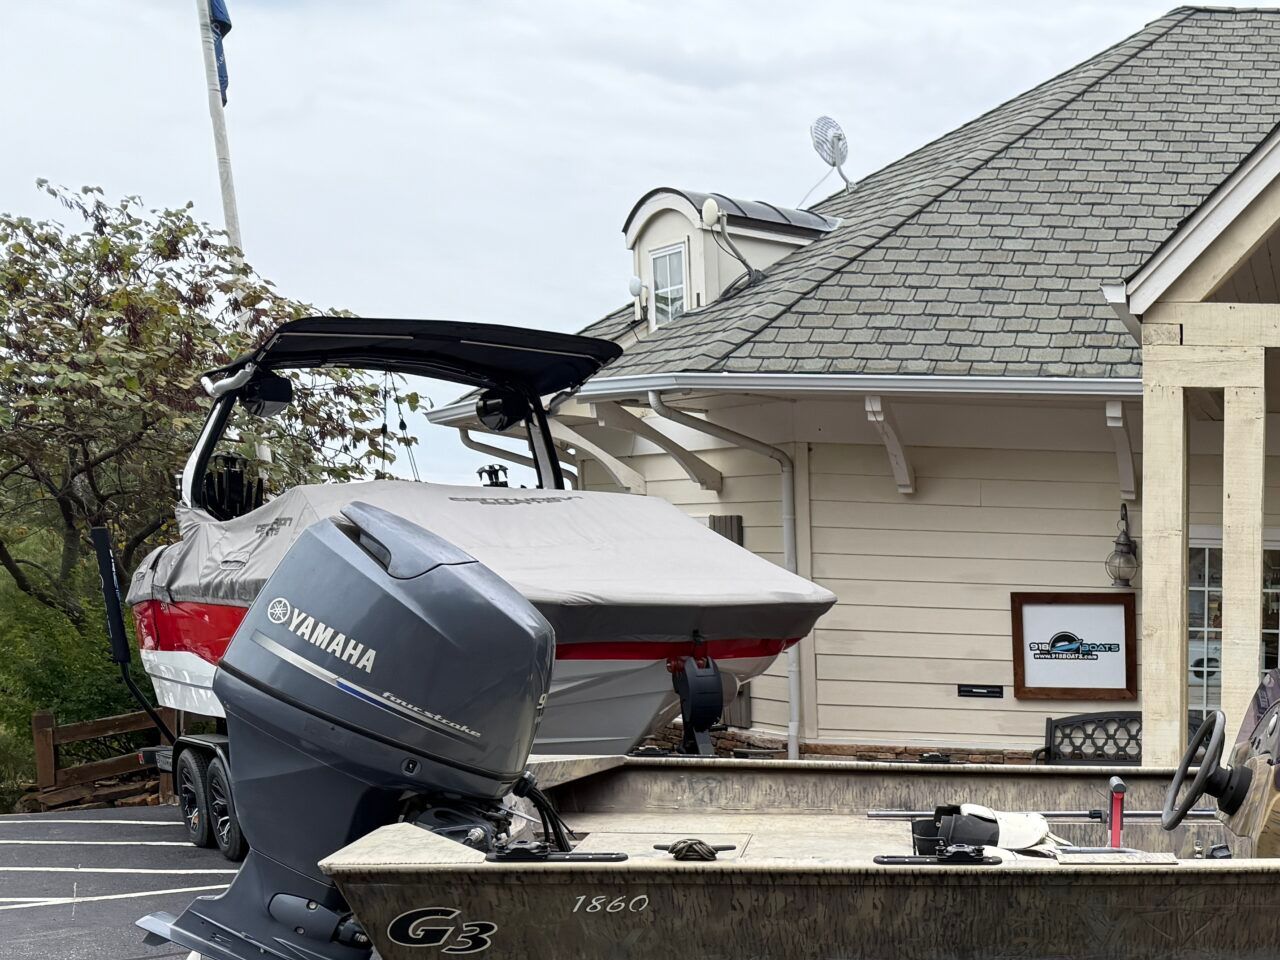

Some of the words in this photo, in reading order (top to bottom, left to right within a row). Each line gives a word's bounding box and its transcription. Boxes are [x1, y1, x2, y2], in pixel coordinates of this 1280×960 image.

[287, 608, 376, 674] YAMAHA
[1030, 643, 1050, 651] 918
[1081, 644, 1120, 652] BOATS
[572, 895, 649, 913] 1860
[387, 907, 498, 954] G3
